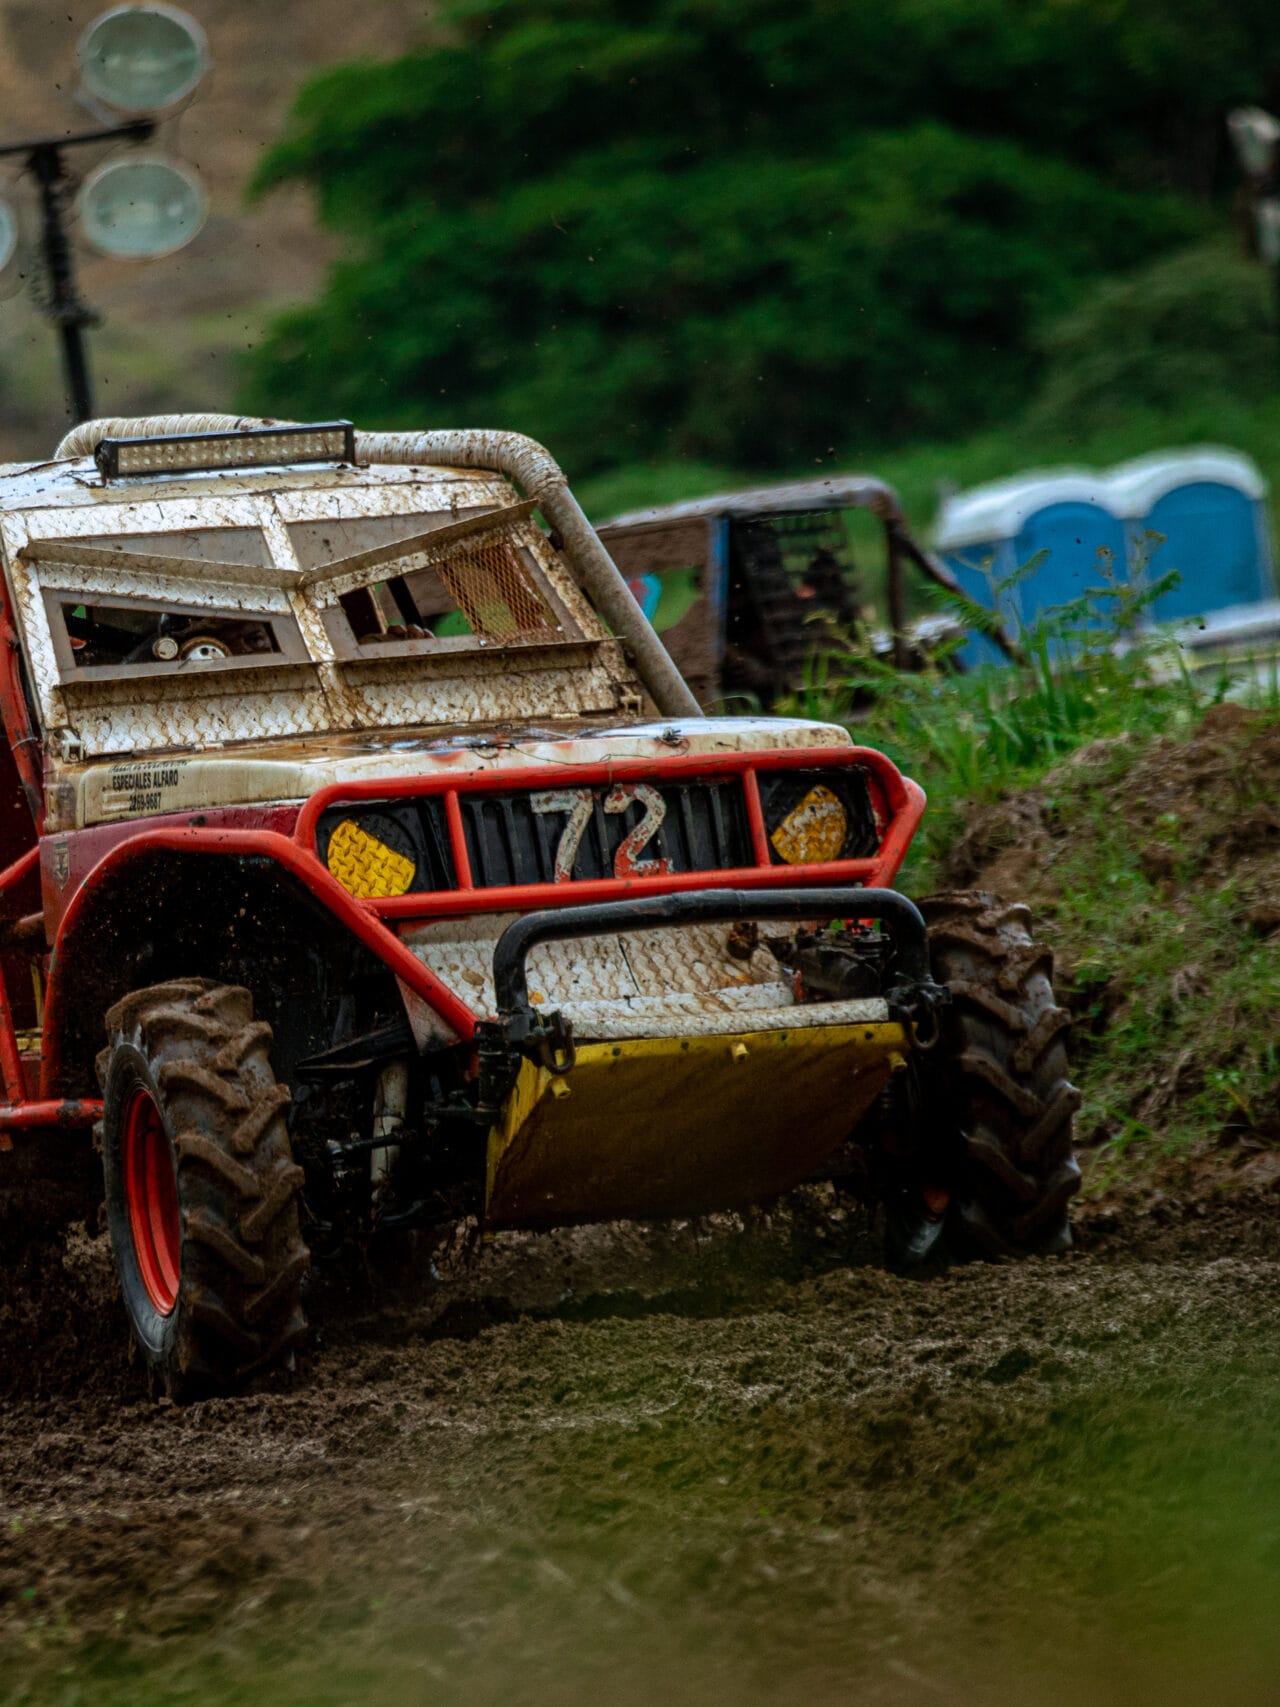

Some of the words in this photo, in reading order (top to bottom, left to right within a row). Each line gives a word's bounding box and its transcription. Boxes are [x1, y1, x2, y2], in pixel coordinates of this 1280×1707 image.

[113, 772, 151, 790] ESPECIALES
[153, 769, 179, 788] ALFARO
[530, 783, 673, 883] 72
